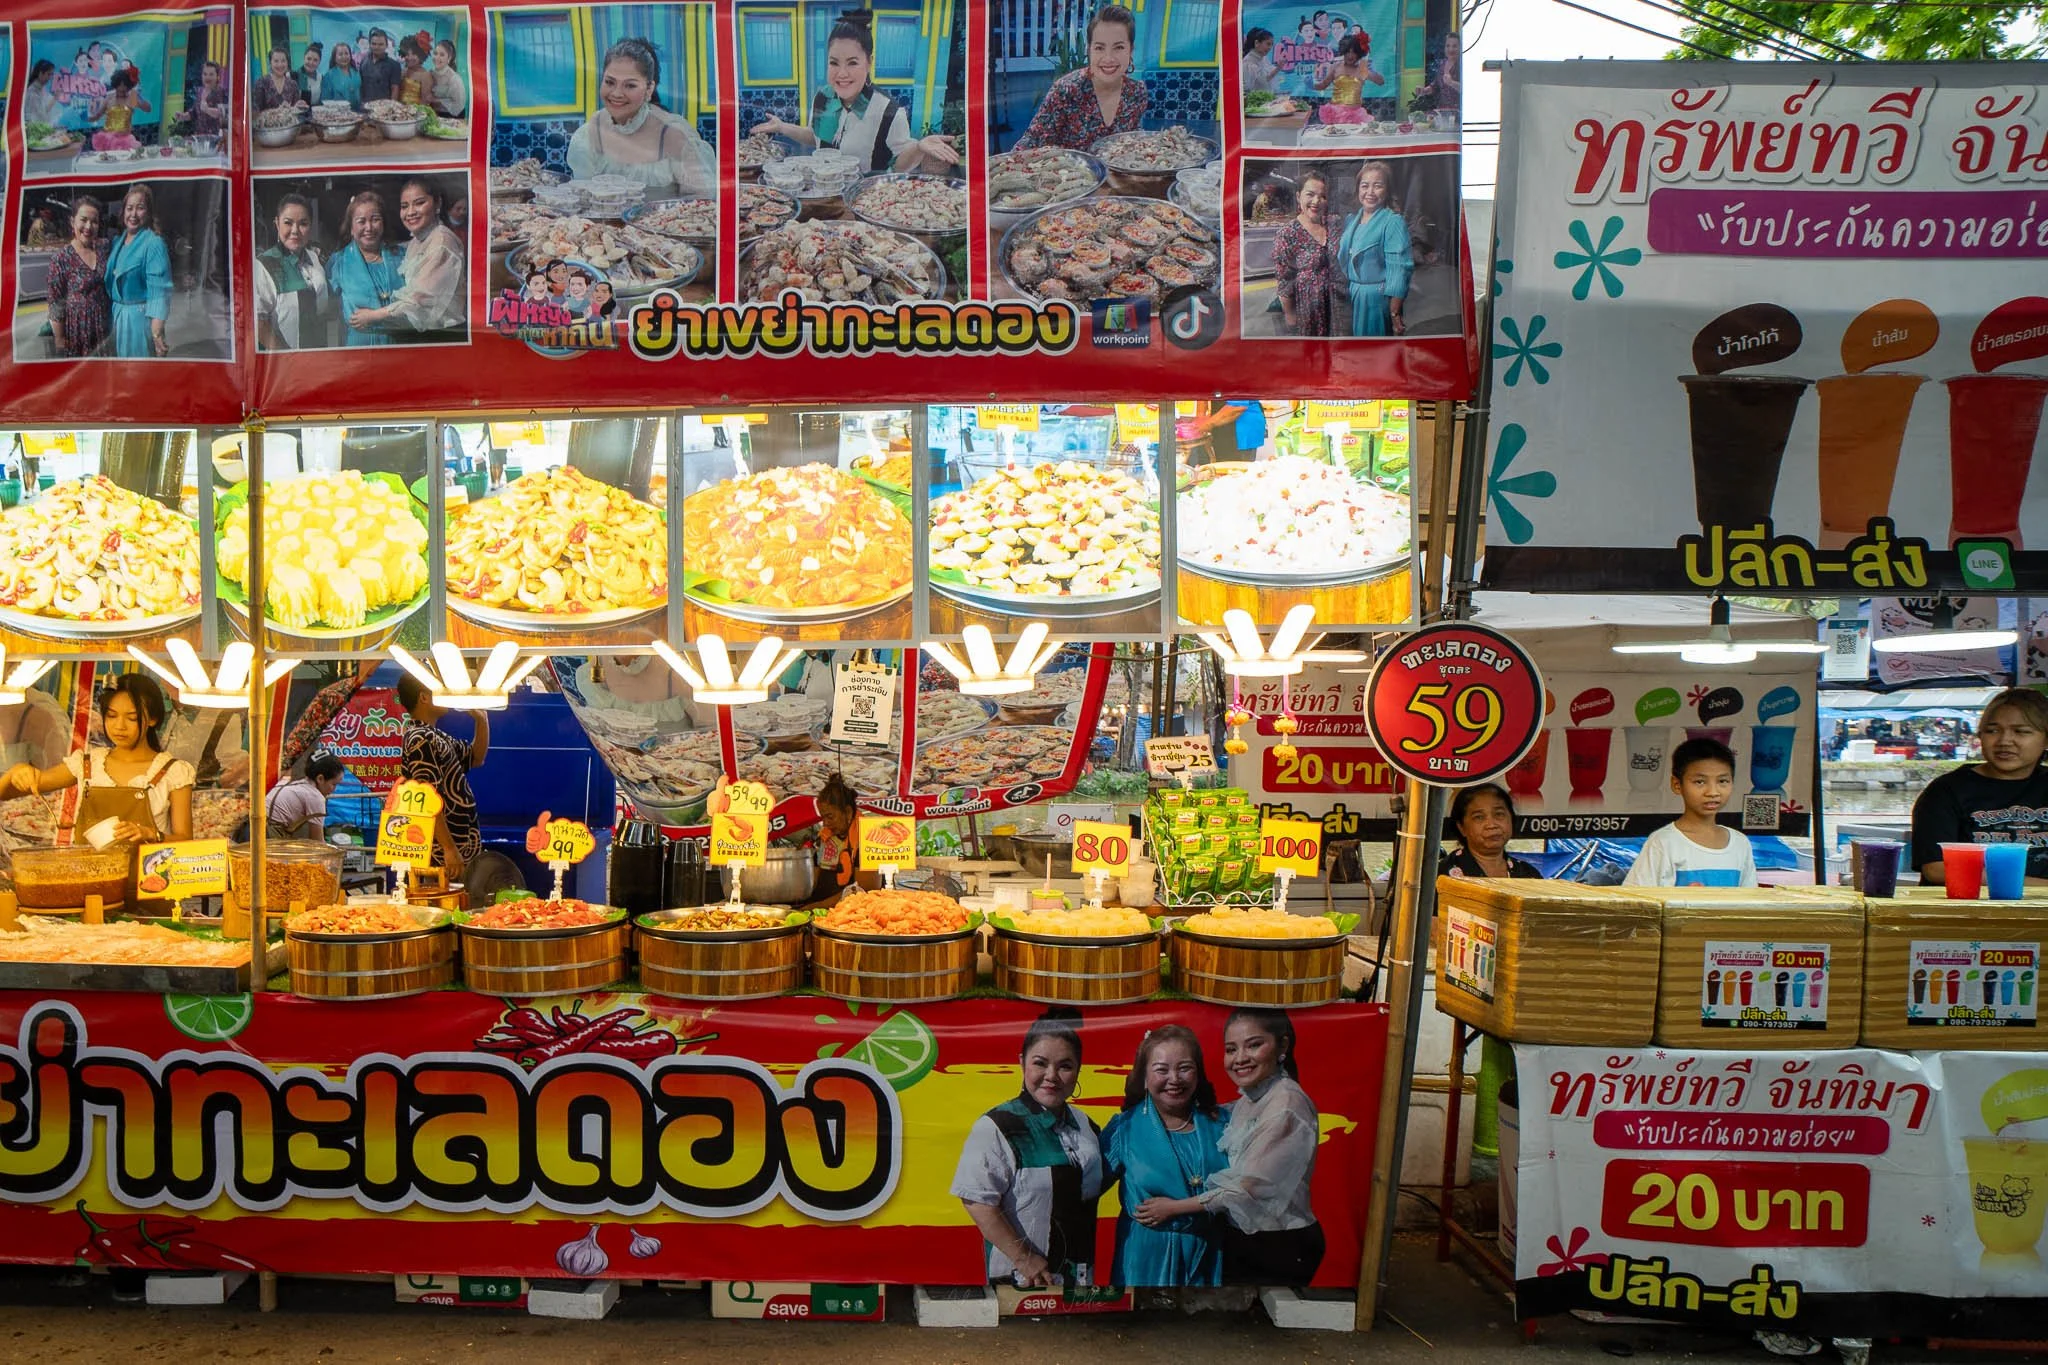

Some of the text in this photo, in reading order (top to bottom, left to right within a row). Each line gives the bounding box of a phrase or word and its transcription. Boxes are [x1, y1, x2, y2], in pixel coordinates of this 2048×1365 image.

[1574, 79, 1923, 194] ทรัพย์ทวี
[1093, 332, 1149, 346] workpoint
[1717, 327, 1779, 356] น้ำโกโก้
[1872, 328, 1909, 348] น้ำส้ม
[1977, 324, 2048, 353] น้ำสตรอเบ
[1685, 523, 1928, 588] ปลีก-ส่ง
[1972, 560, 1999, 569] LINE
[1400, 640, 1513, 673] ทะเลดอง
[1439, 665, 1472, 678] ชุดละ
[1400, 682, 1502, 755] 59
[1187, 754, 1213, 767] 25
[1276, 753, 1324, 785] 20
[1428, 756, 1469, 772] บาท
[402, 790, 426, 813] 99
[732, 785, 768, 811] 59 99
[1532, 816, 1630, 832] 090-7973957
[383, 849, 424, 860] (SALMON)
[553, 840, 574, 859] 99
[1075, 833, 1128, 865] 80
[1262, 833, 1317, 860] 100
[191, 865, 212, 873] 200
[1776, 952, 1821, 966] 20 บาท
[1984, 951, 2030, 964] 20 บาท
[1741, 1007, 1787, 1020] ปลีก-ส่ง
[1948, 1006, 1996, 1019] ปลีก-ส่ง
[1743, 1020, 1798, 1029] 090-7973957
[1549, 1054, 1931, 1129] ทรัพย์ทวี จันทิมา
[1627, 1173, 1845, 1231] 20 บาท
[1588, 1256, 1798, 1320] ปลีก-ส่ง
[768, 1303, 809, 1316] save
[1023, 1298, 1057, 1309] save
